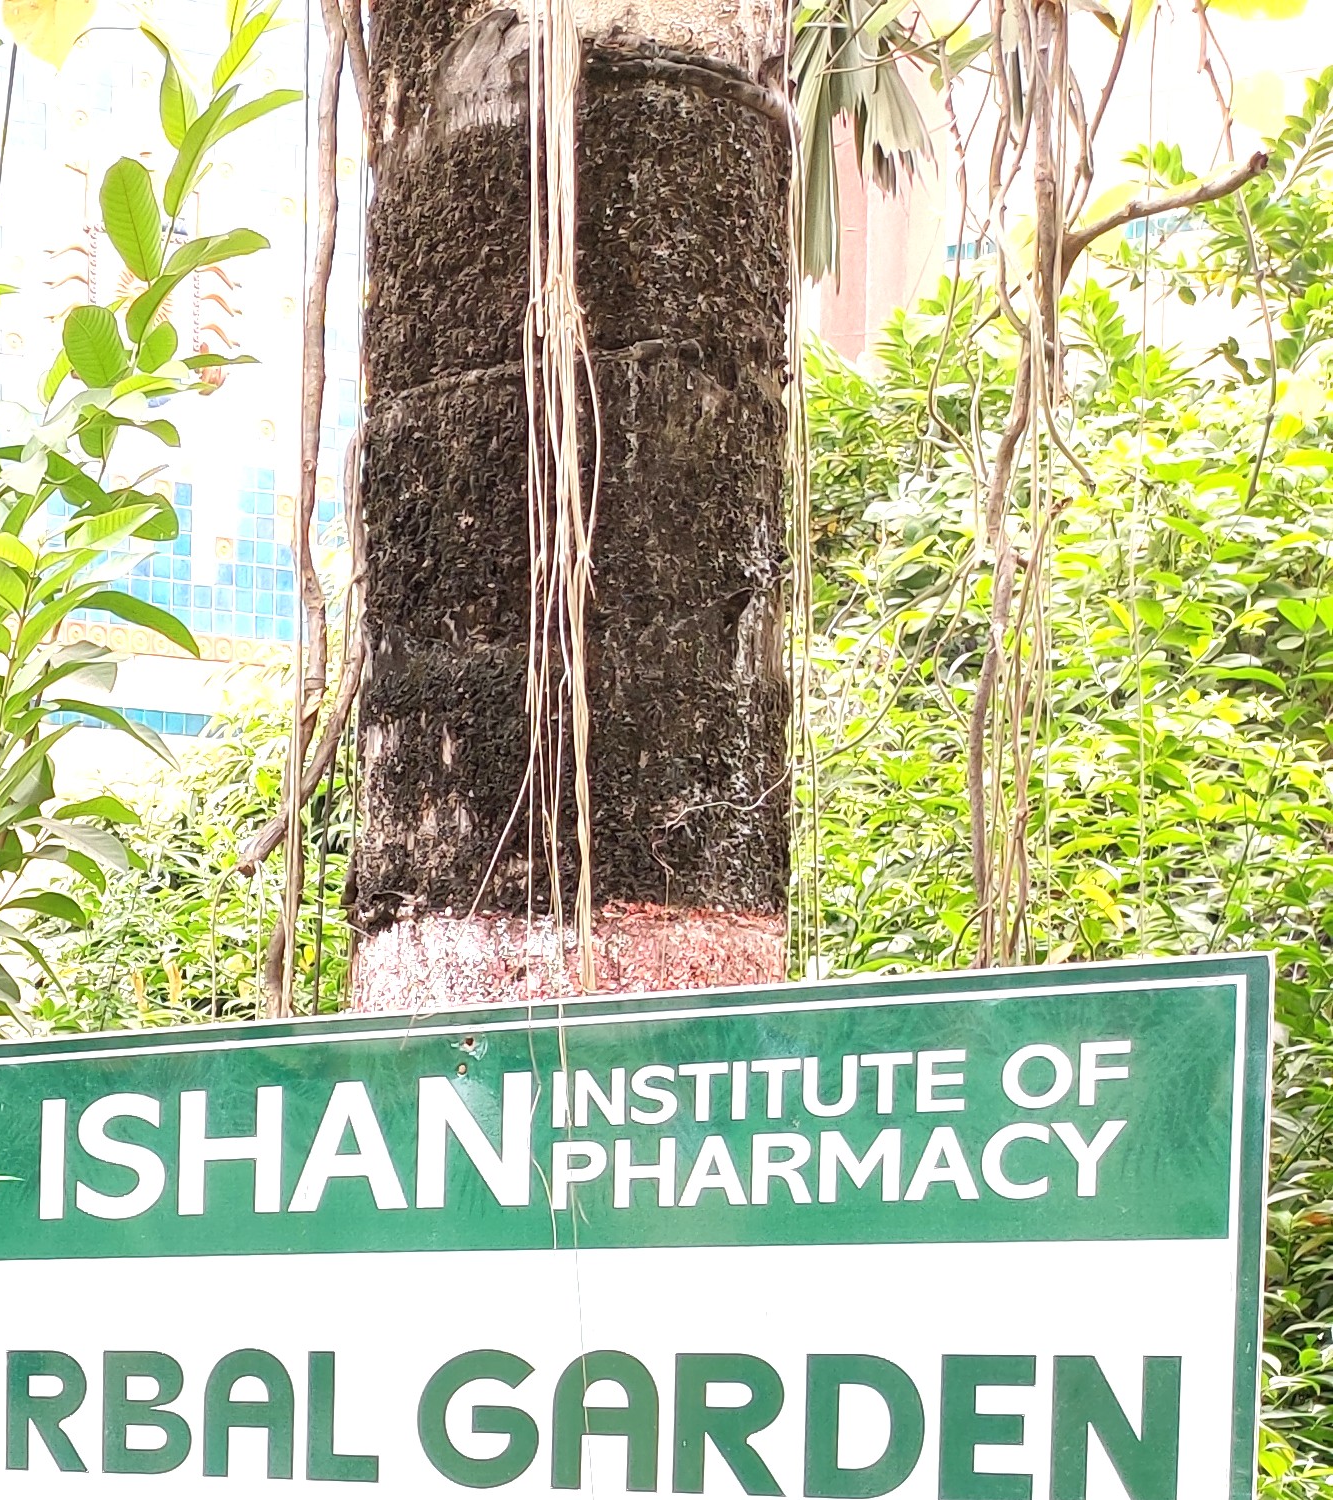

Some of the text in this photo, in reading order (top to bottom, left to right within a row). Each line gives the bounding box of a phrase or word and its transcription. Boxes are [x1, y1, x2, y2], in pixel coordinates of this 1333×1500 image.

[551, 1041, 1133, 1128] INSTITUTE OF
[39, 1072, 530, 1220] ISHAN
[551, 1120, 1128, 1211] PHARMACY
